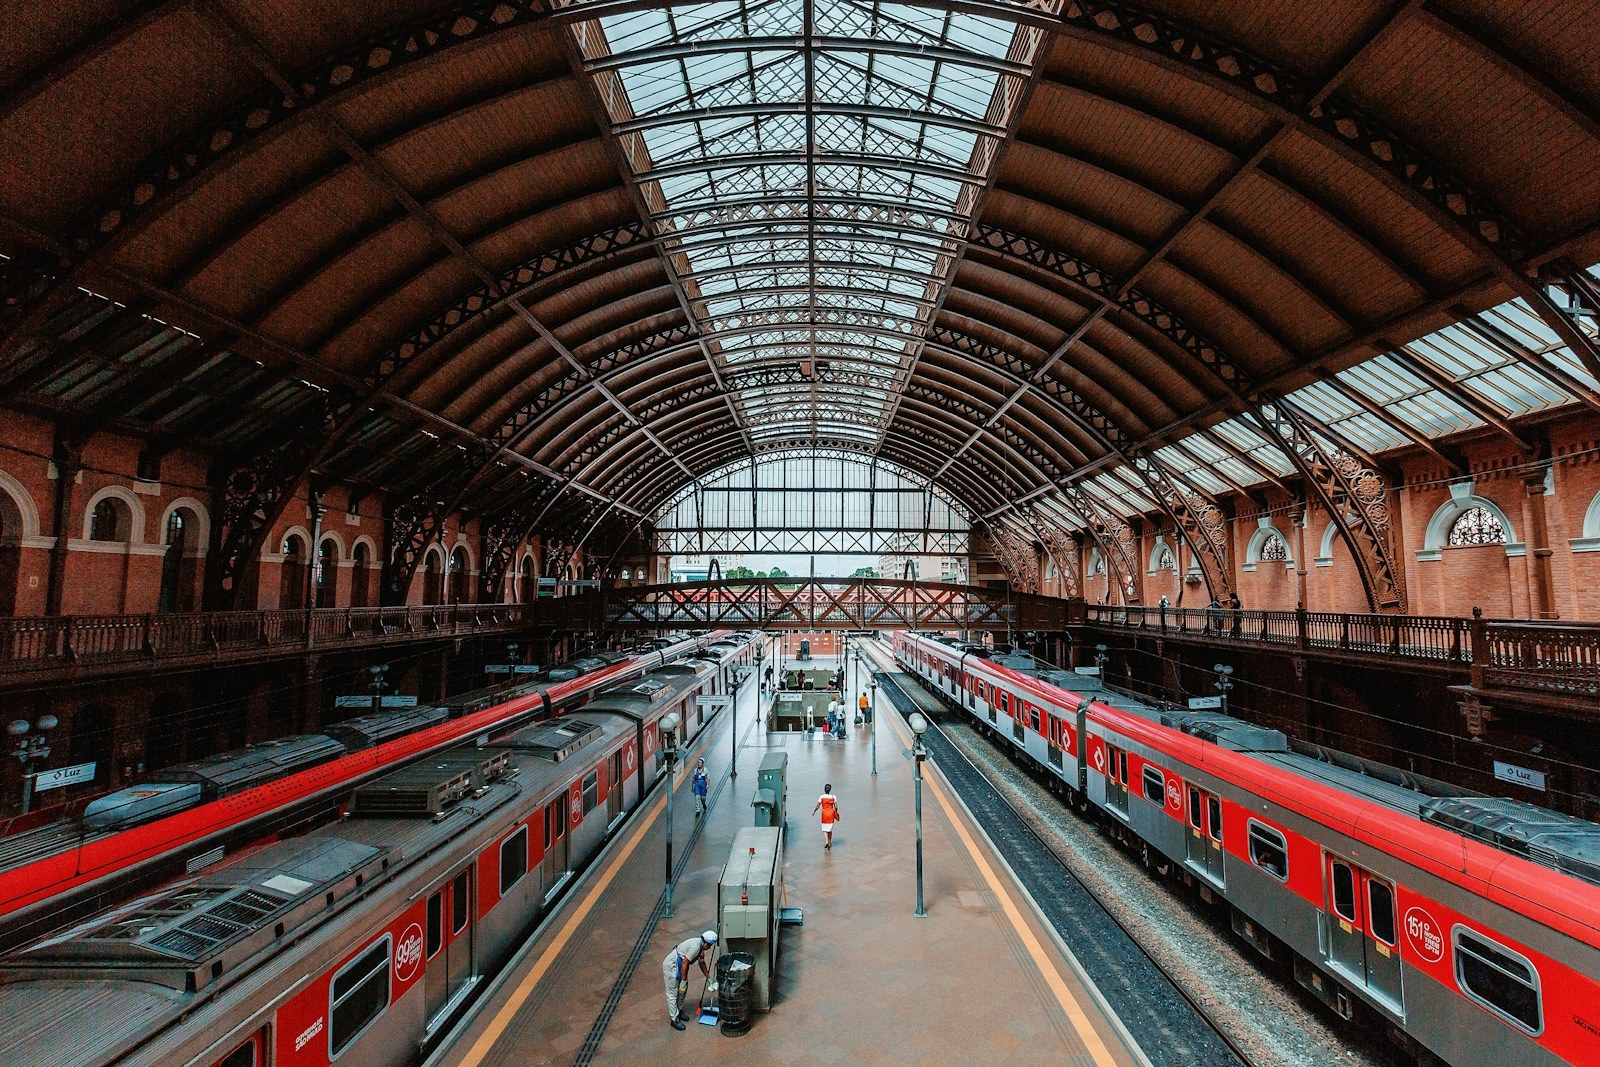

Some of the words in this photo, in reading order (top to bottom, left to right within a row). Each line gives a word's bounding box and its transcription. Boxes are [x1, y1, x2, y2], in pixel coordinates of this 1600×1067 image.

[64, 769, 81, 778] Luz
[1516, 769, 1531, 780] Luz
[1424, 930, 1440, 943] NOVO
[1424, 936, 1440, 950] TREM
[1425, 943, 1440, 956] CPTM
[295, 1021, 317, 1044] GOVERNO
[306, 1023, 323, 1042] PAULO
